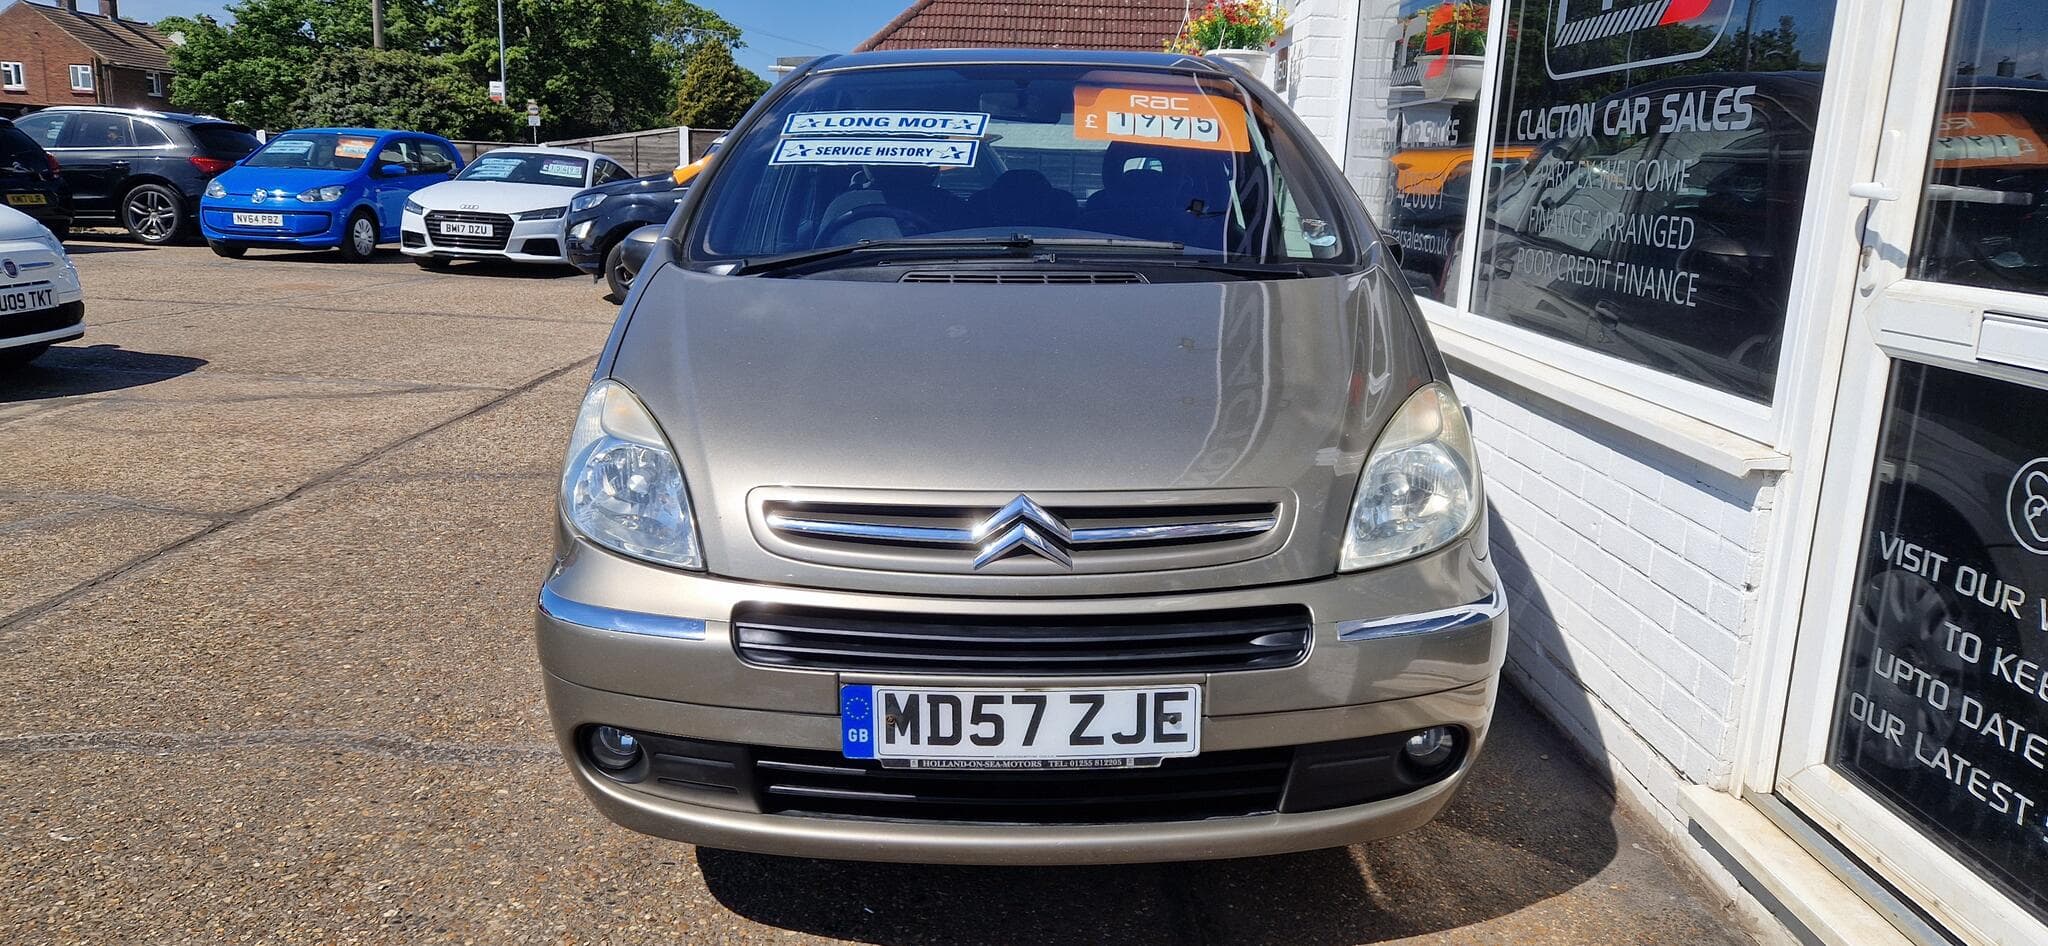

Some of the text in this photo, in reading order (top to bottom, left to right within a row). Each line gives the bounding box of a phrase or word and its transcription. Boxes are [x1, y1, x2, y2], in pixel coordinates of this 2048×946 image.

[824, 117, 953, 128] LONG MOT
[1517, 85, 1756, 141] CLACTON CAR SALES
[815, 146, 933, 157] SERVICE HISTORY
[1541, 159, 1694, 192] PART EX WELCOME
[236, 214, 279, 225] NV64 PBZ
[446, 223, 487, 235] BM17 DZU
[1528, 206, 1695, 250] FINANCE ARRANGED
[1516, 247, 1700, 307] POOR CREDIT FINANCE
[29, 289, 52, 308] TKT
[1880, 531, 1948, 582] VISIT
[1955, 566, 2025, 619] OUR
[1944, 621, 1982, 664] TO
[884, 691, 1190, 747] MD57 ZJE
[1874, 647, 2048, 769] UPTO DATE
[848, 728, 869, 743] GB
[1069, 759, 1093, 767] 01255
[1850, 691, 2034, 826] OUR LATEST
